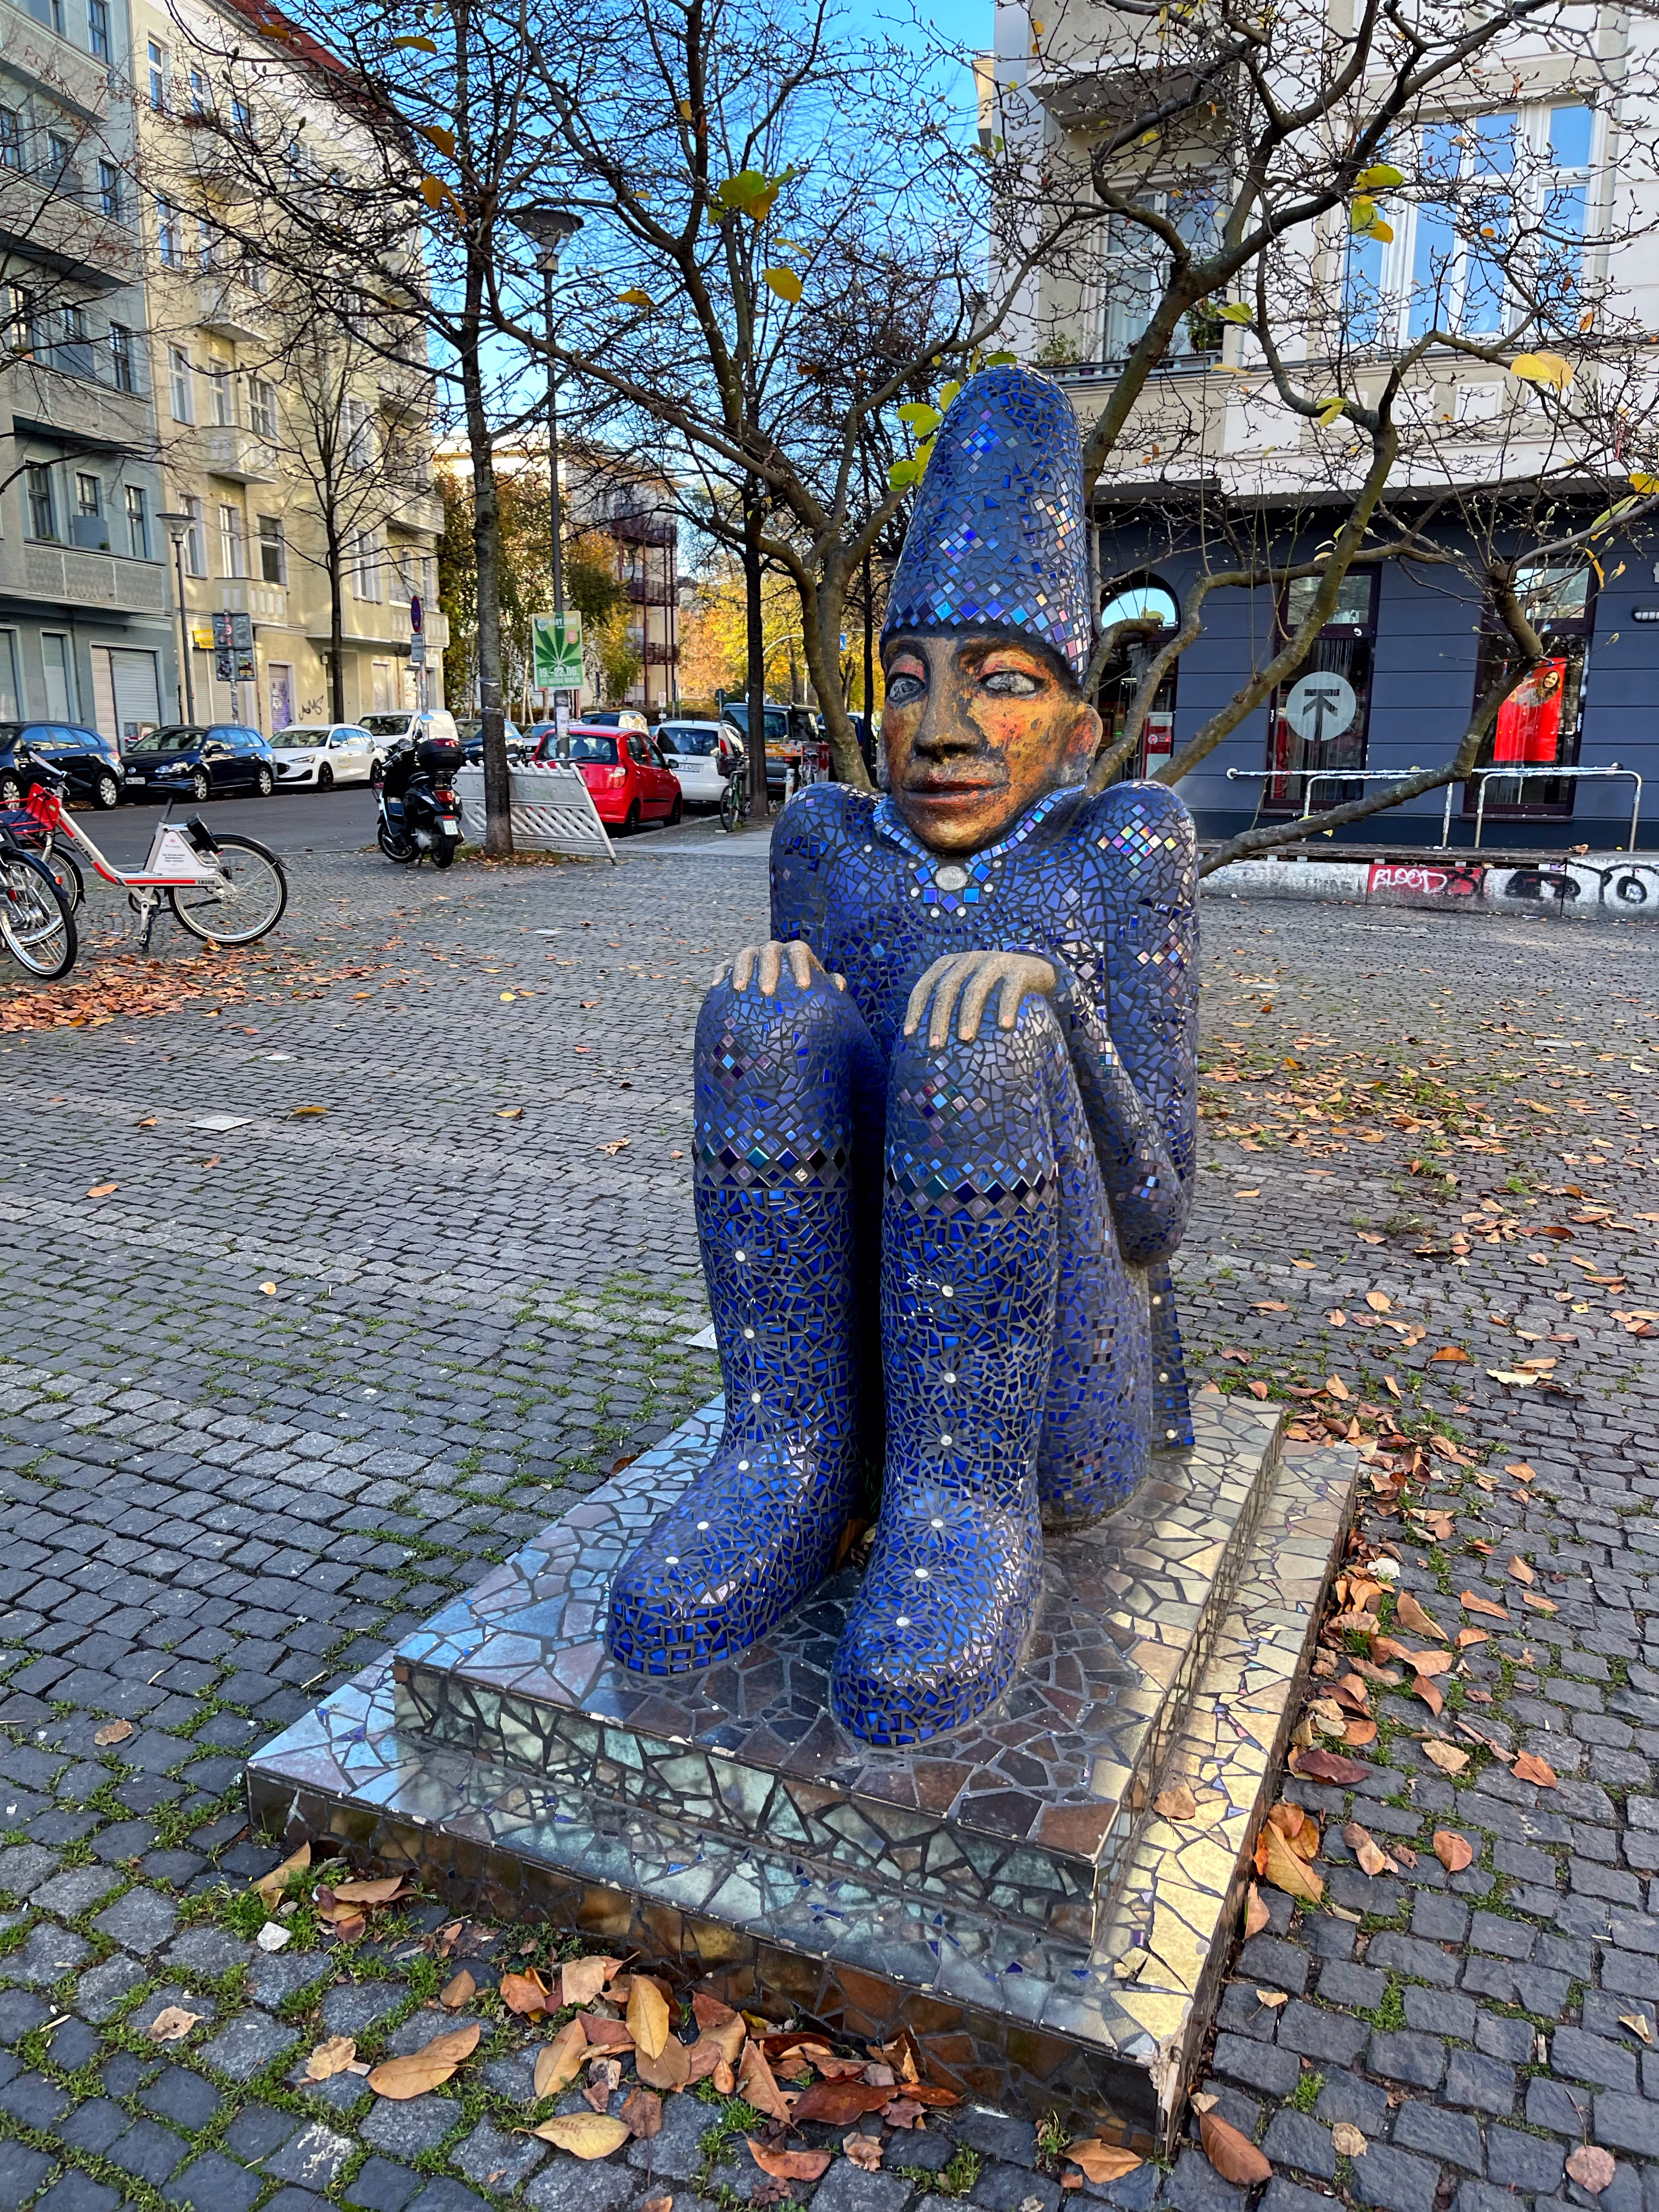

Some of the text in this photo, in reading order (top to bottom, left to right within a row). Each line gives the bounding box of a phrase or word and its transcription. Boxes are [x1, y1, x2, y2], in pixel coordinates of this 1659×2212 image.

[74, 838, 83, 848] Call
[83, 850, 93, 861] Bike
[1373, 867, 1448, 895] BLOOD
